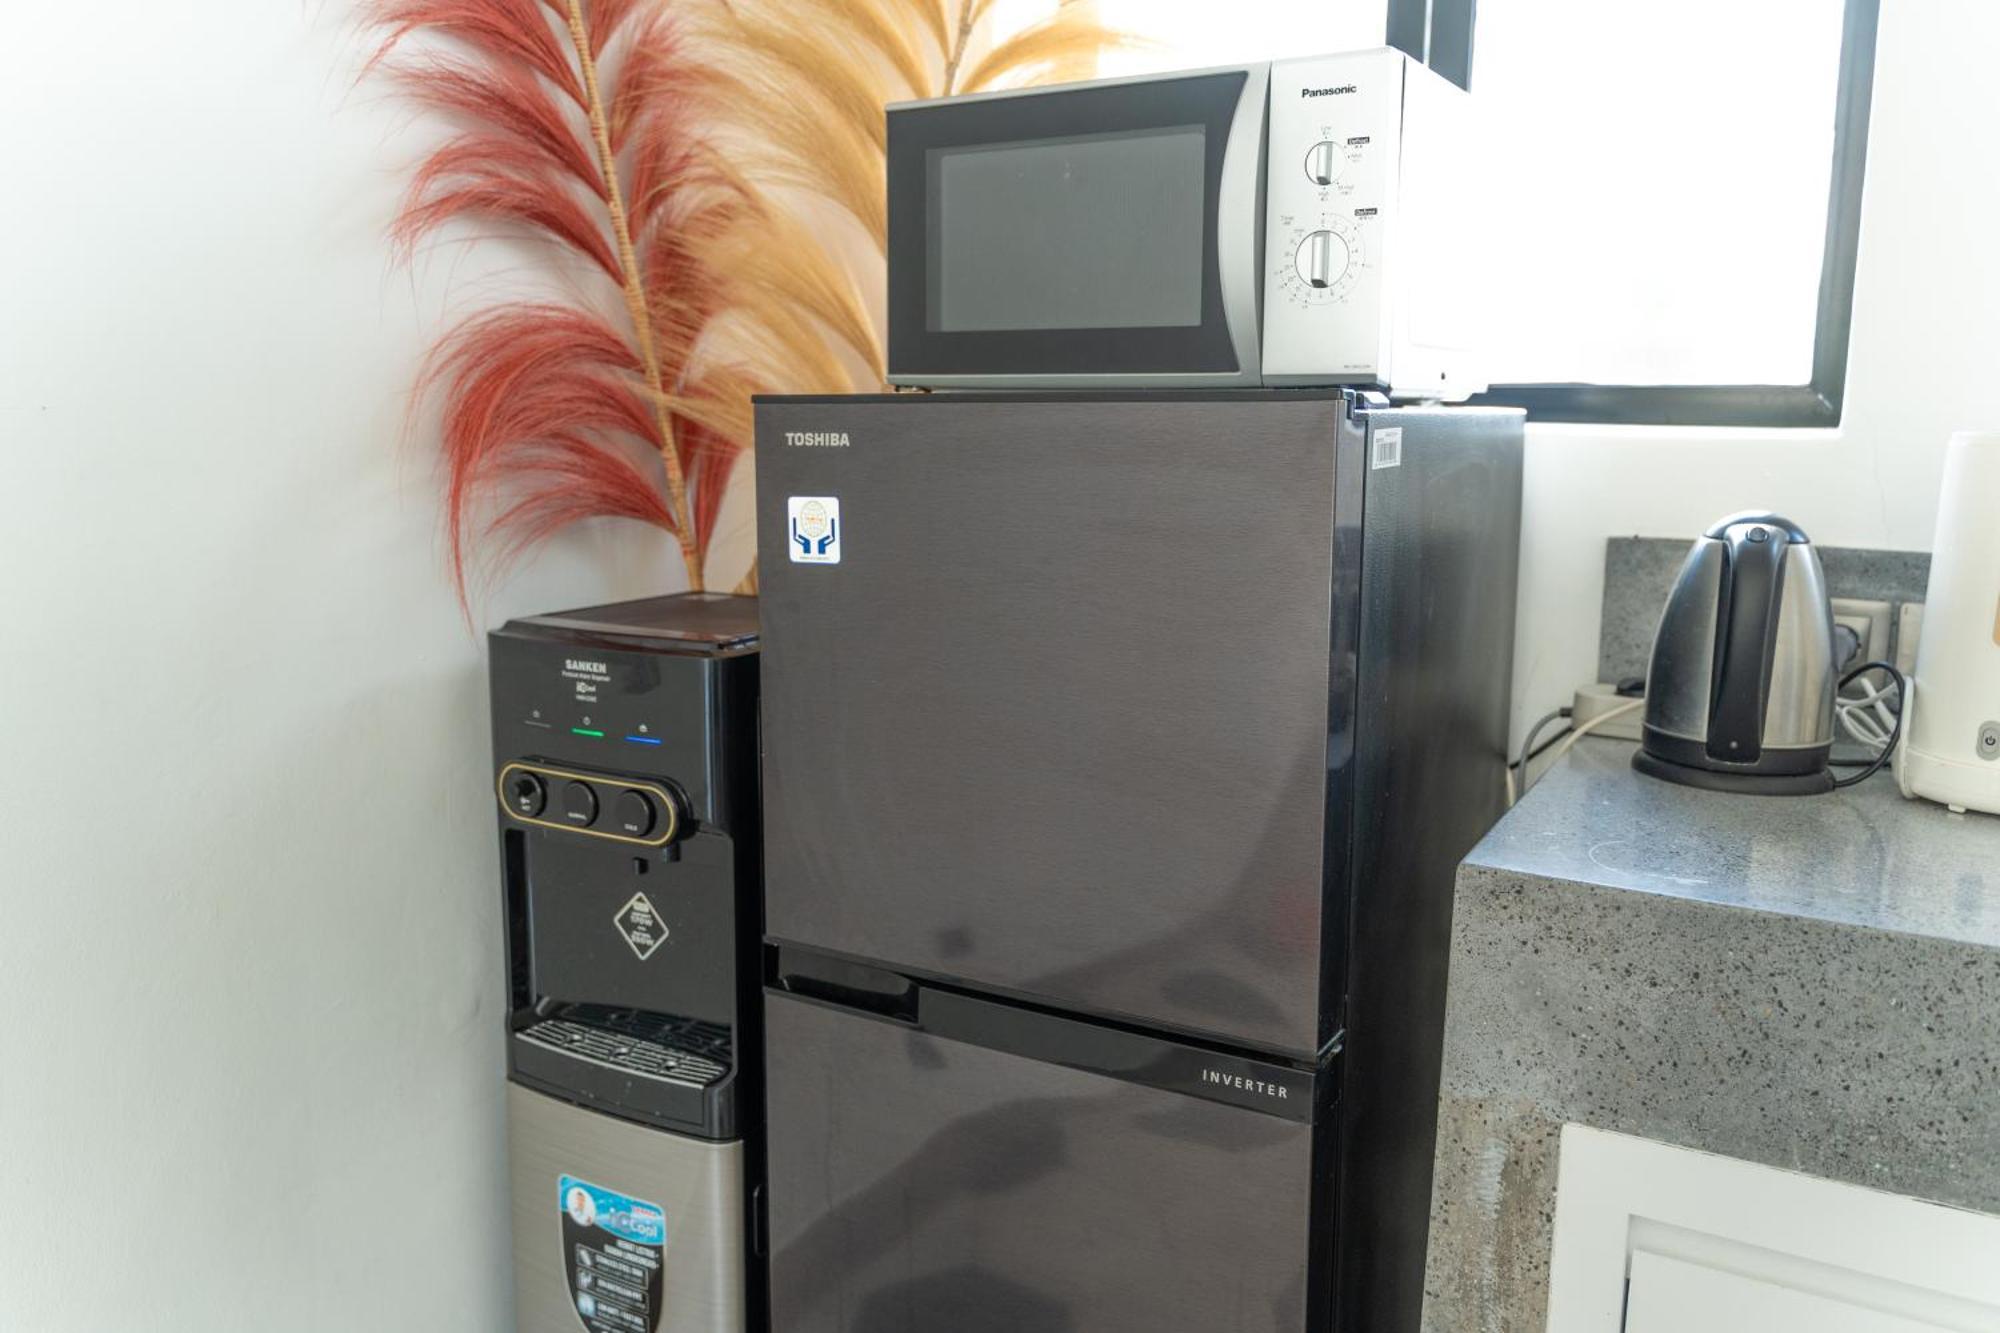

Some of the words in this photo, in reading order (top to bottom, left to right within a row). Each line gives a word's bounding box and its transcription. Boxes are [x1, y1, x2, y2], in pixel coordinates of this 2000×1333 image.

[1301, 84, 1358, 98] Panasonic
[785, 432, 851, 447] TOSHIBA
[565, 659, 607, 673] SANKEN
[1202, 1069, 1288, 1099] INVERTER
